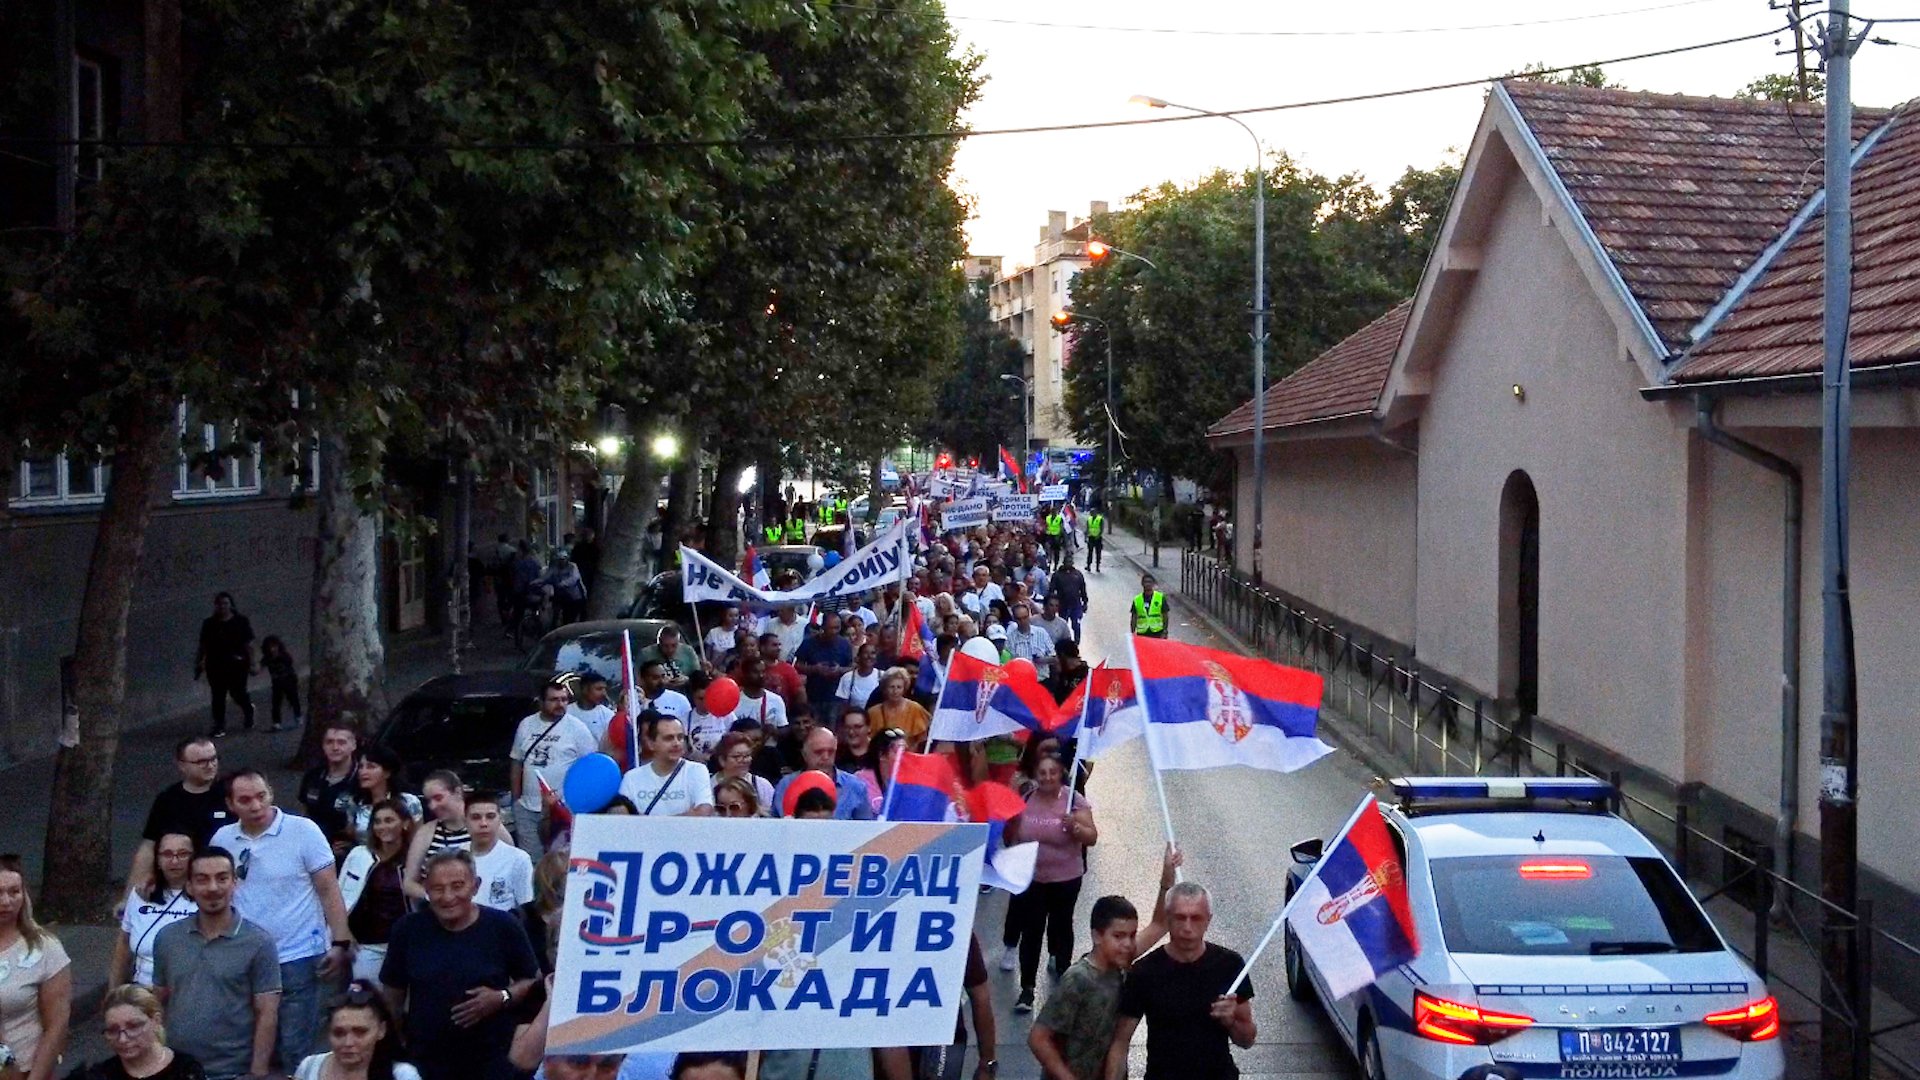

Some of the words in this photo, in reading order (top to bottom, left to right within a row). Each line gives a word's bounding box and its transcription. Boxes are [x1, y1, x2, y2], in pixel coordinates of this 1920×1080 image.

[687, 563, 724, 589] Не
[637, 788, 686, 801] addas
[582, 850, 962, 955] ПОЖАРЕВАЦ
[575, 966, 944, 1018] БЛОКАДА
[1560, 1067, 1678, 1079] ПОЛИЦИЈА
